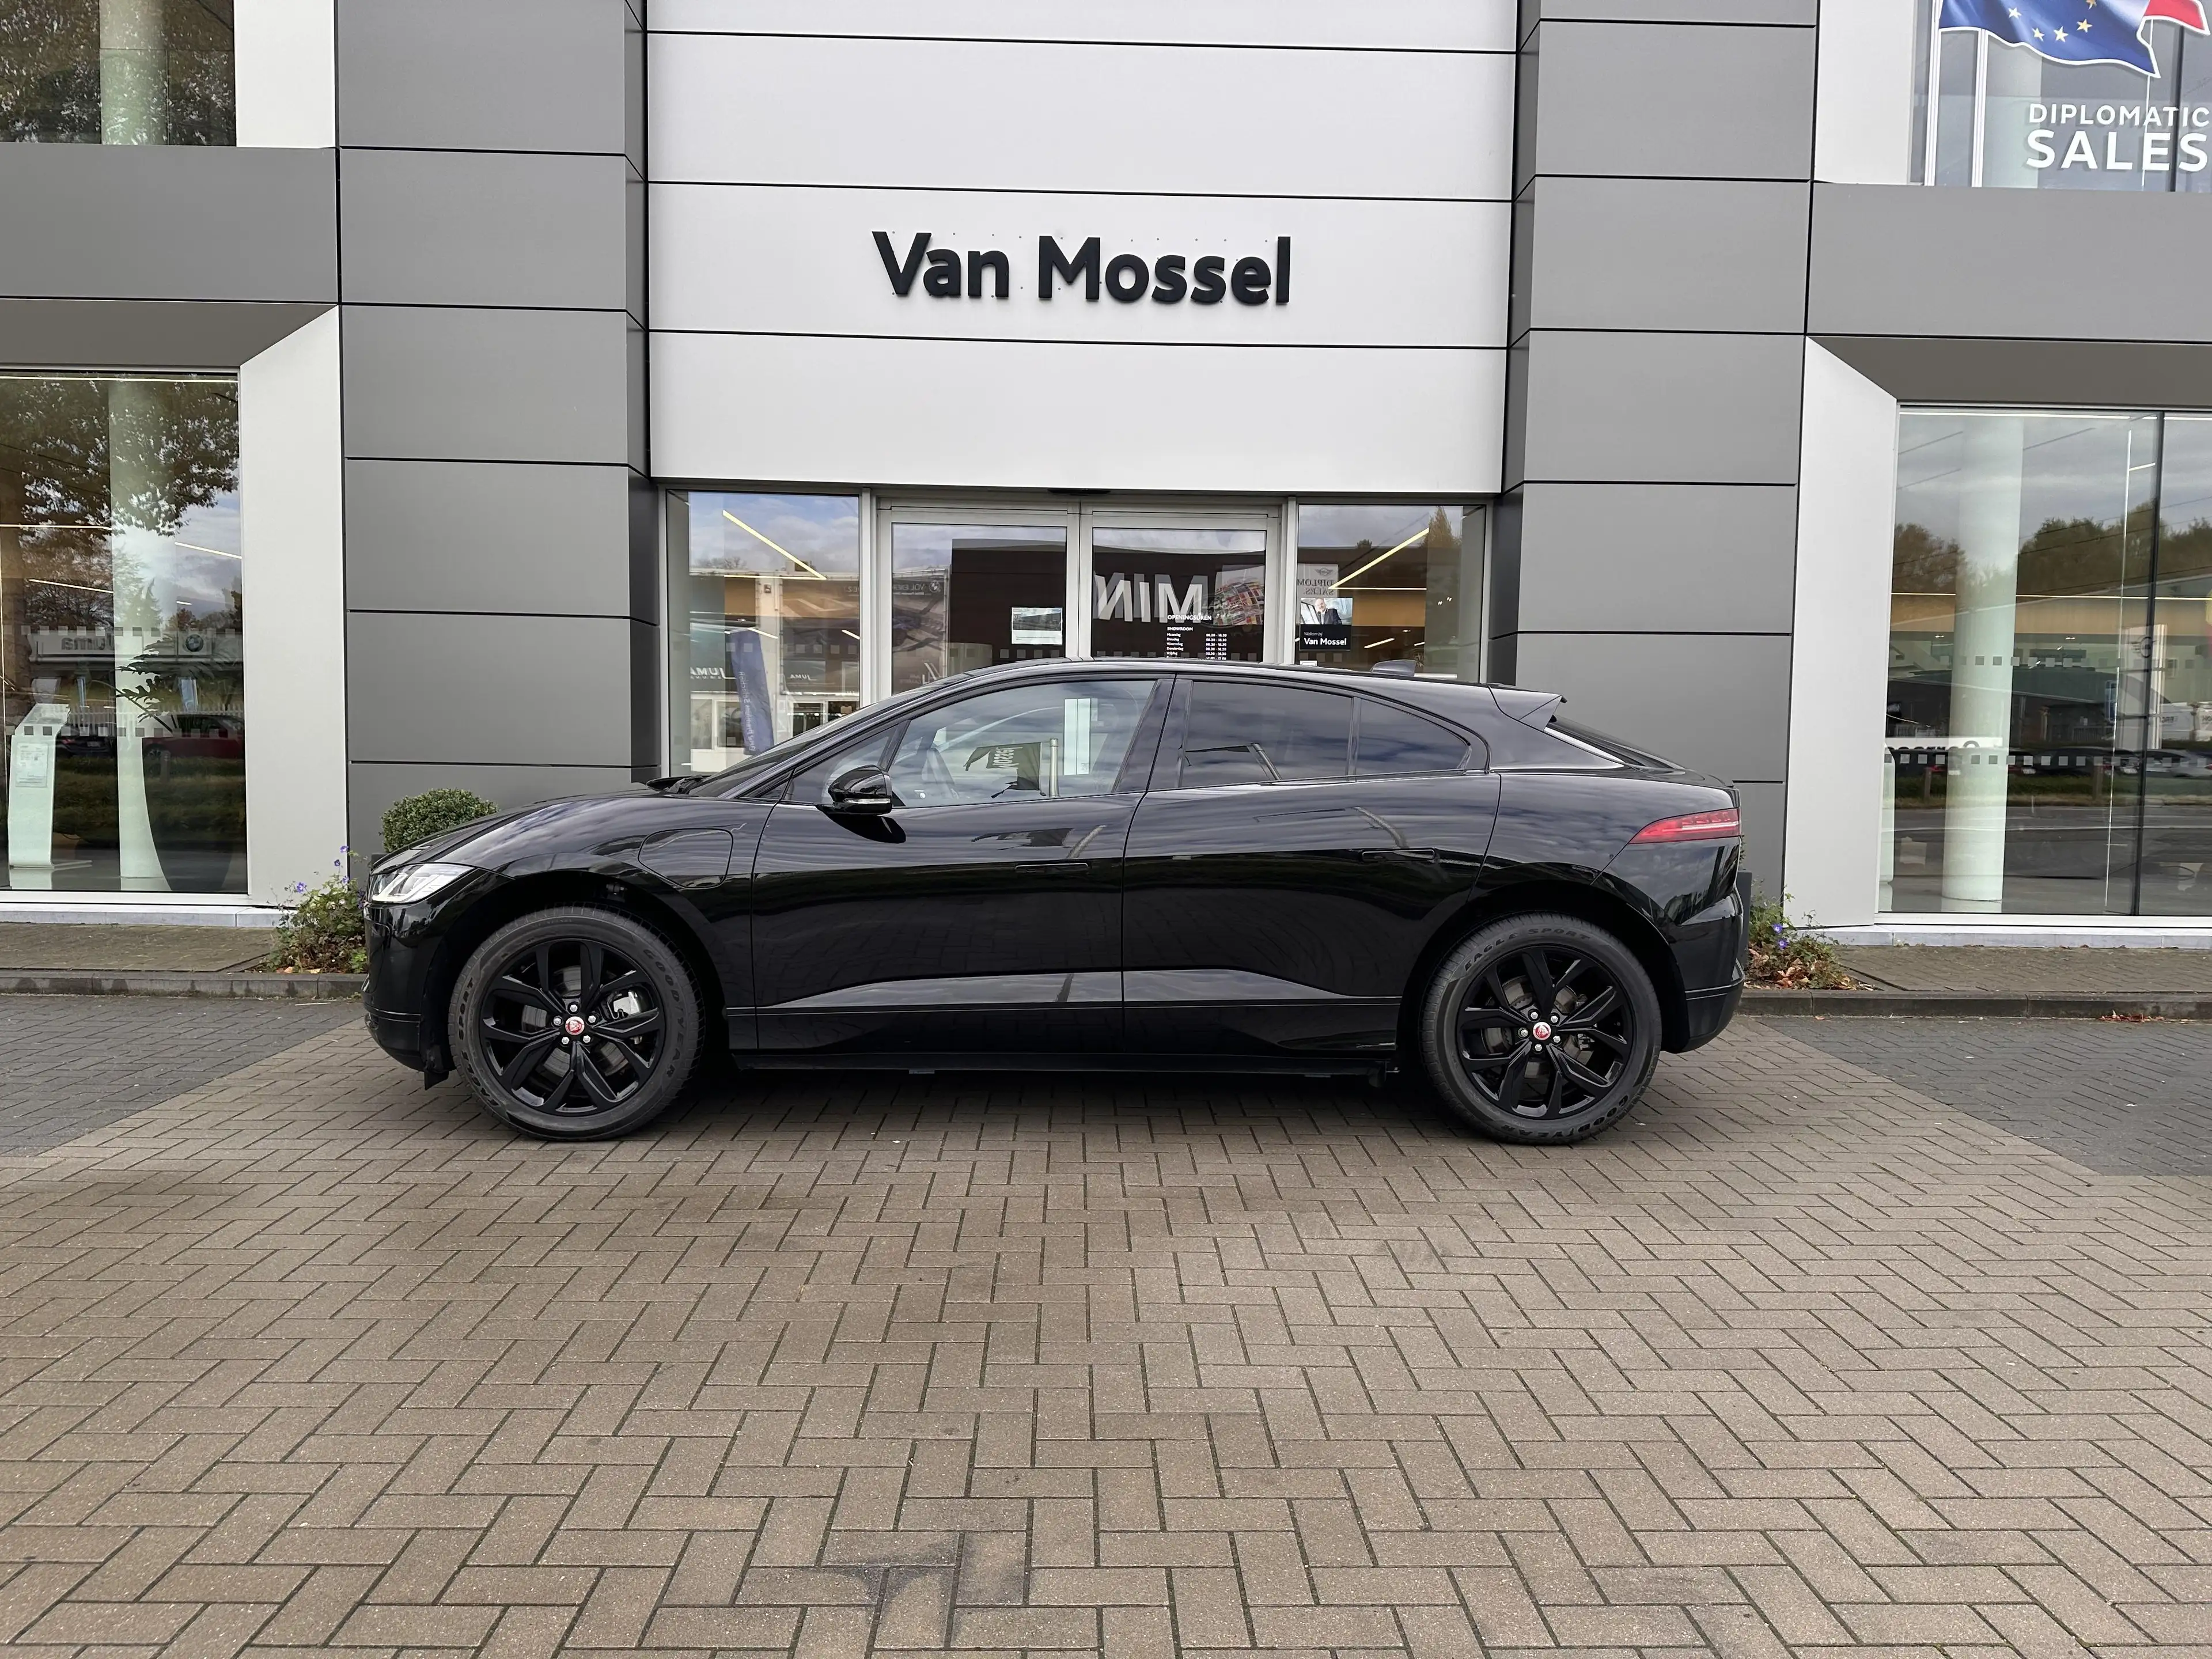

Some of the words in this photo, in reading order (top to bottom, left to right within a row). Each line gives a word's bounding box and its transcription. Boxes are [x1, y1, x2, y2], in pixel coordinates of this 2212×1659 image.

[2029, 103, 2210, 127] DIPLOMATIC
[2025, 128, 2209, 172] SALES
[872, 230, 1010, 298] Van
[1038, 236, 1291, 304] Mossel
[1464, 932, 1519, 971] EAGLE
[1528, 927, 1590, 940] SPORT
[458, 977, 474, 1040] SPORT
